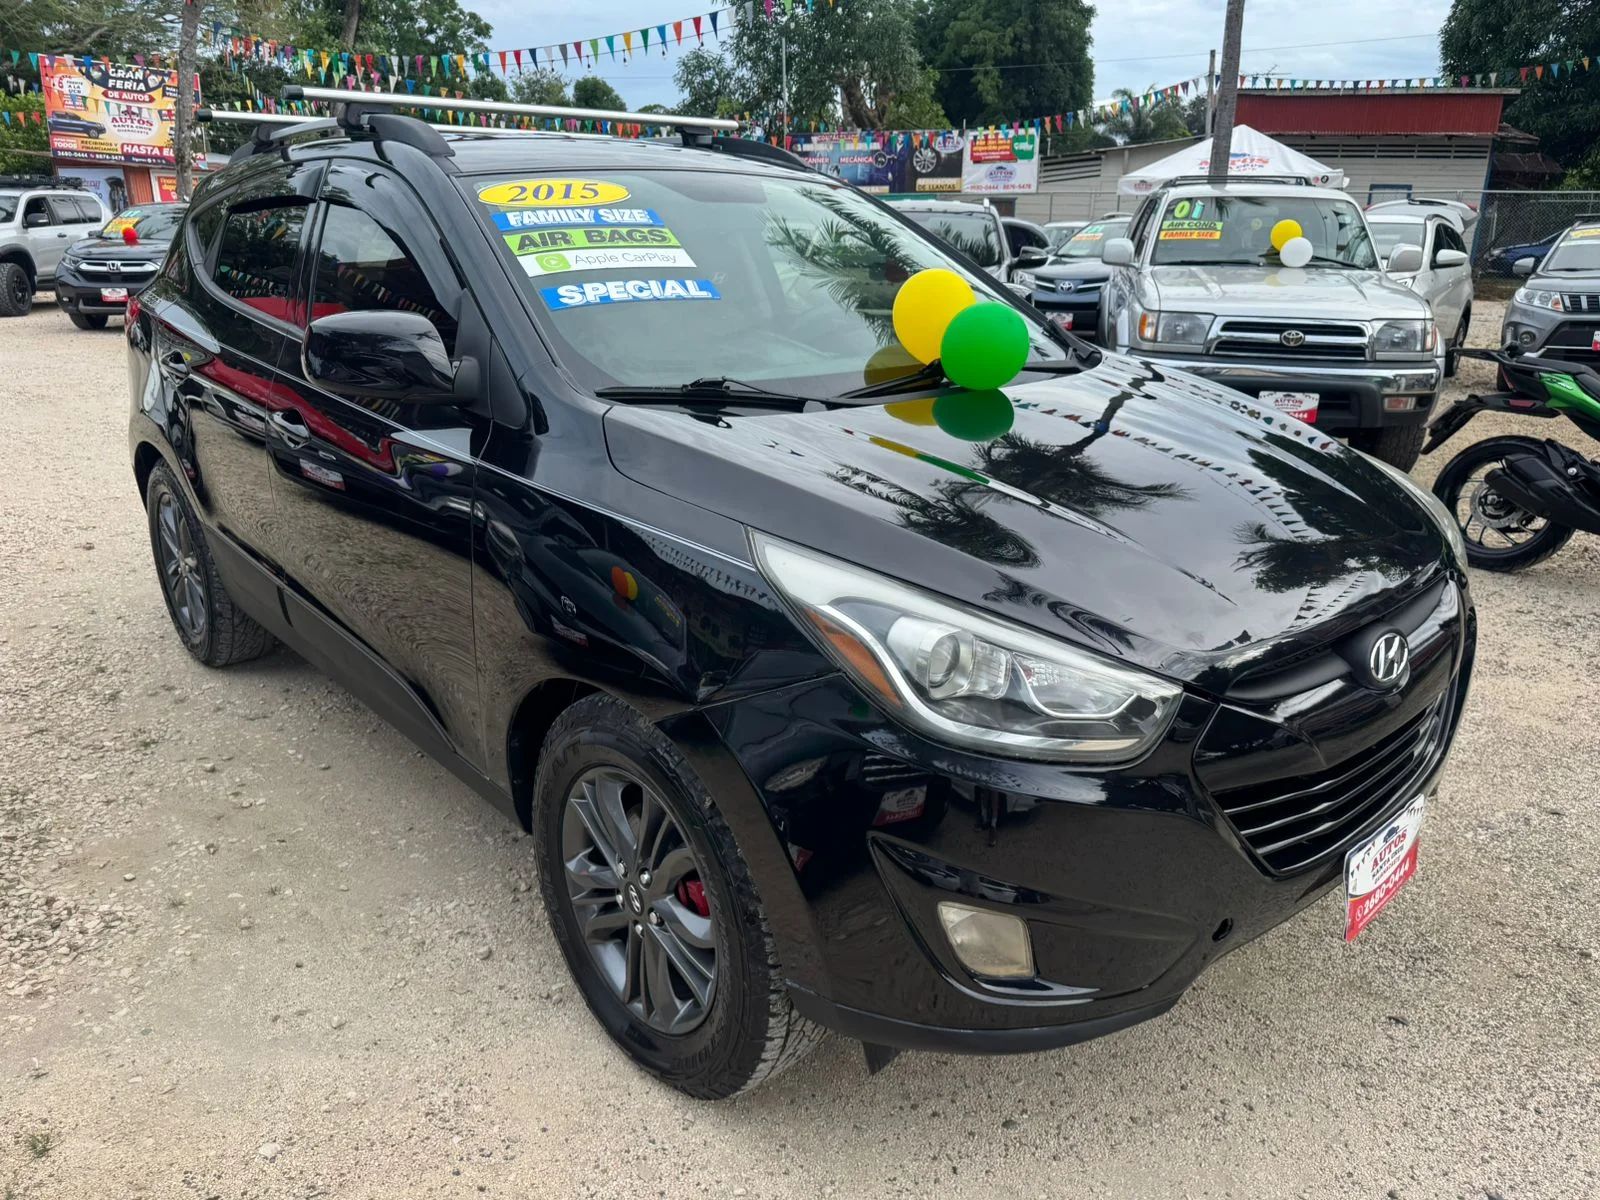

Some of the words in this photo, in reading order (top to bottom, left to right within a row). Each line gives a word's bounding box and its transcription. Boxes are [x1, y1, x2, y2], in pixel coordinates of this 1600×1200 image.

[108, 68, 143, 80] GRAN
[108, 79, 146, 91] FERIA
[107, 90, 120, 99] DE
[122, 92, 150, 101] AUTOS
[111, 116, 154, 127] AUTOS
[123, 144, 160, 156] HASTA
[839, 155, 874, 164] MECÁNICA
[507, 182, 600, 203] 2015
[507, 208, 594, 227] FAMILY
[598, 208, 653, 225] SIZE
[1174, 200, 1205, 220] 01
[517, 230, 576, 251] AIR
[583, 228, 671, 245] BAGS
[575, 253, 619, 266] Apple
[623, 252, 677, 265] CarPlay
[557, 278, 713, 306] SPECIAL
[1371, 828, 1408, 873] AUTOS
[1363, 858, 1410, 916] 2680-0444
